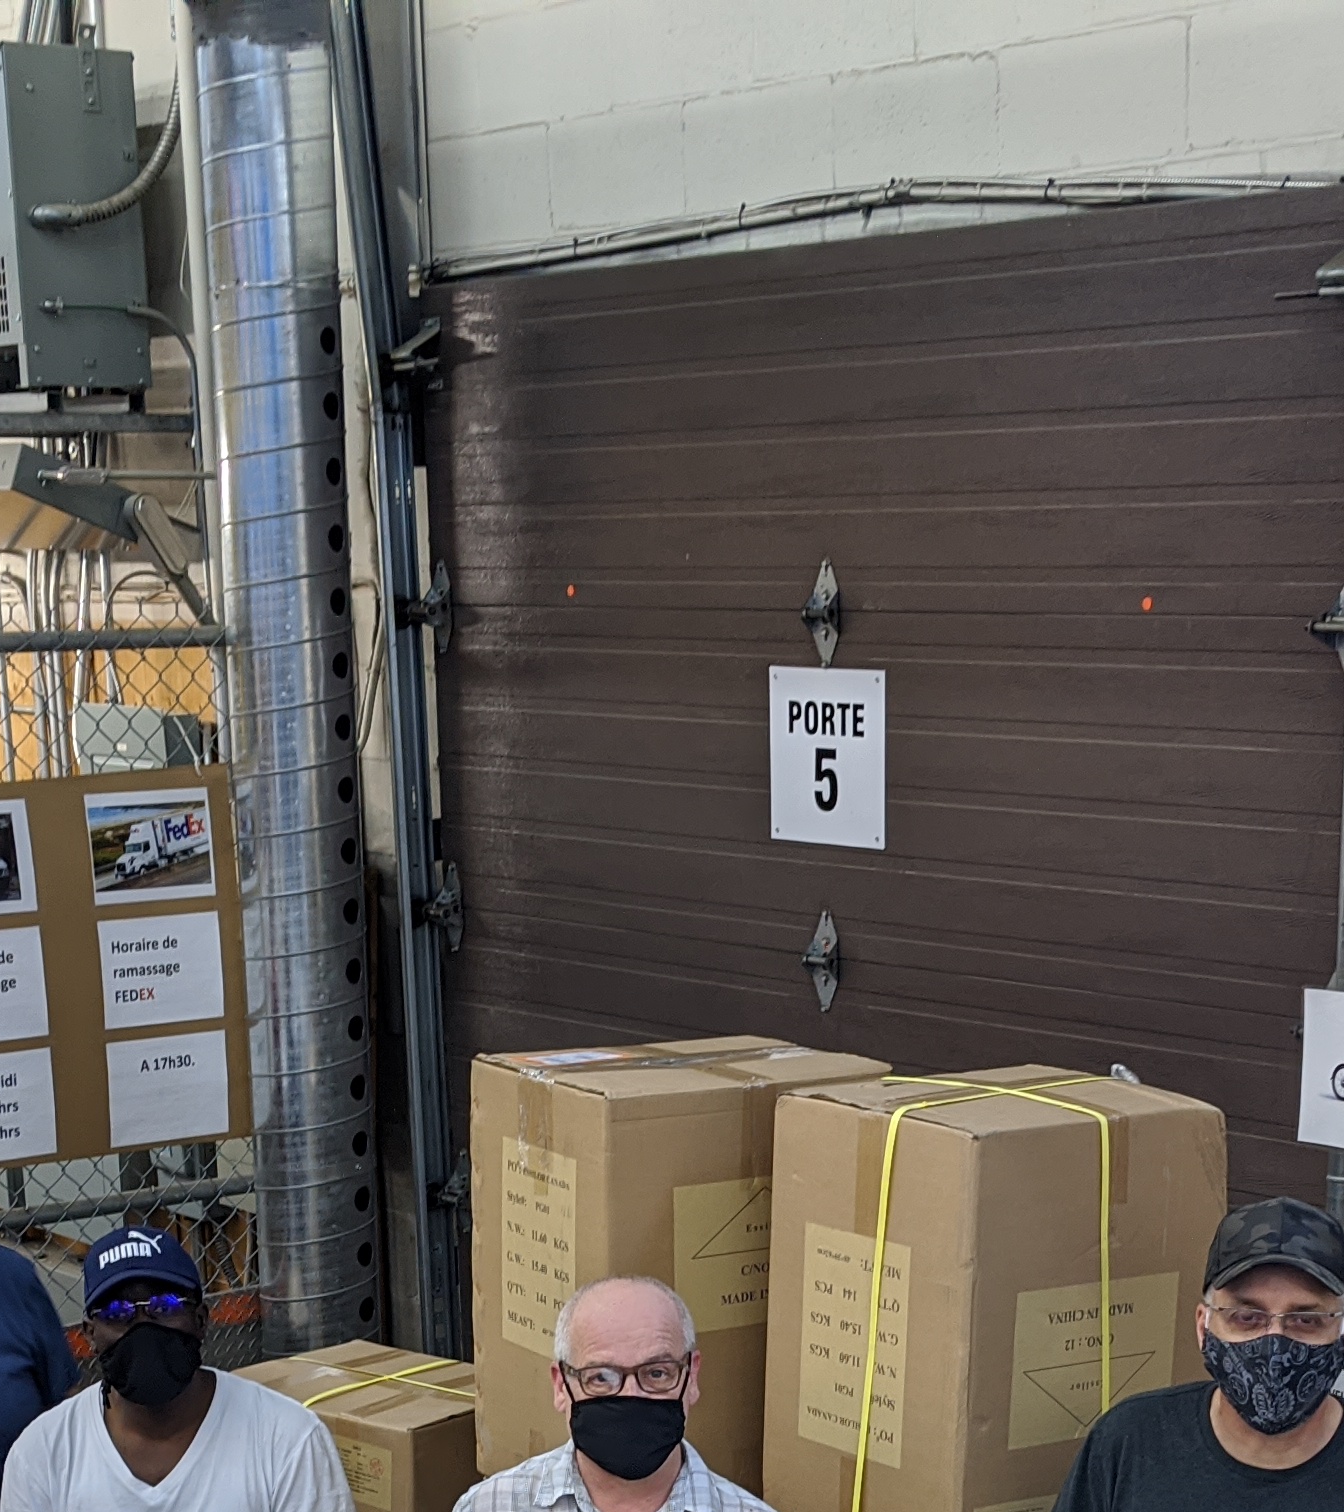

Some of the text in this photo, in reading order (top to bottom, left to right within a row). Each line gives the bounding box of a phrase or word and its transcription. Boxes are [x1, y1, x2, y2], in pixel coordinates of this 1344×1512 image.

[789, 701, 865, 737] PORTE
[815, 747, 838, 811] 5
[164, 812, 205, 843] FedEx
[111, 935, 178, 954] Horaire de
[113, 961, 180, 979] ramassage
[115, 987, 155, 1004] FEDEX
[140, 1055, 196, 1073] A 17h30.
[0, 1125, 21, 1140] hrs
[553, 1237, 570, 1252] KGS
[99, 1242, 152, 1270] PUMA
[554, 1268, 570, 1283] KGS
[815, 1280, 833, 1295] PCS
[843, 1287, 857, 1302] 144
[536, 1292, 547, 1305] 144
[721, 1291, 757, 1307] MADE
[810, 1311, 831, 1327] KGS
[1047, 1302, 1134, 1326] MAD IN CHINA
[840, 1319, 862, 1336] 15.40
[809, 1343, 830, 1359] KGS
[1064, 1339, 1076, 1352] 12
[839, 1352, 860, 1368] 11.60
[807, 1405, 838, 1424] CANADA
